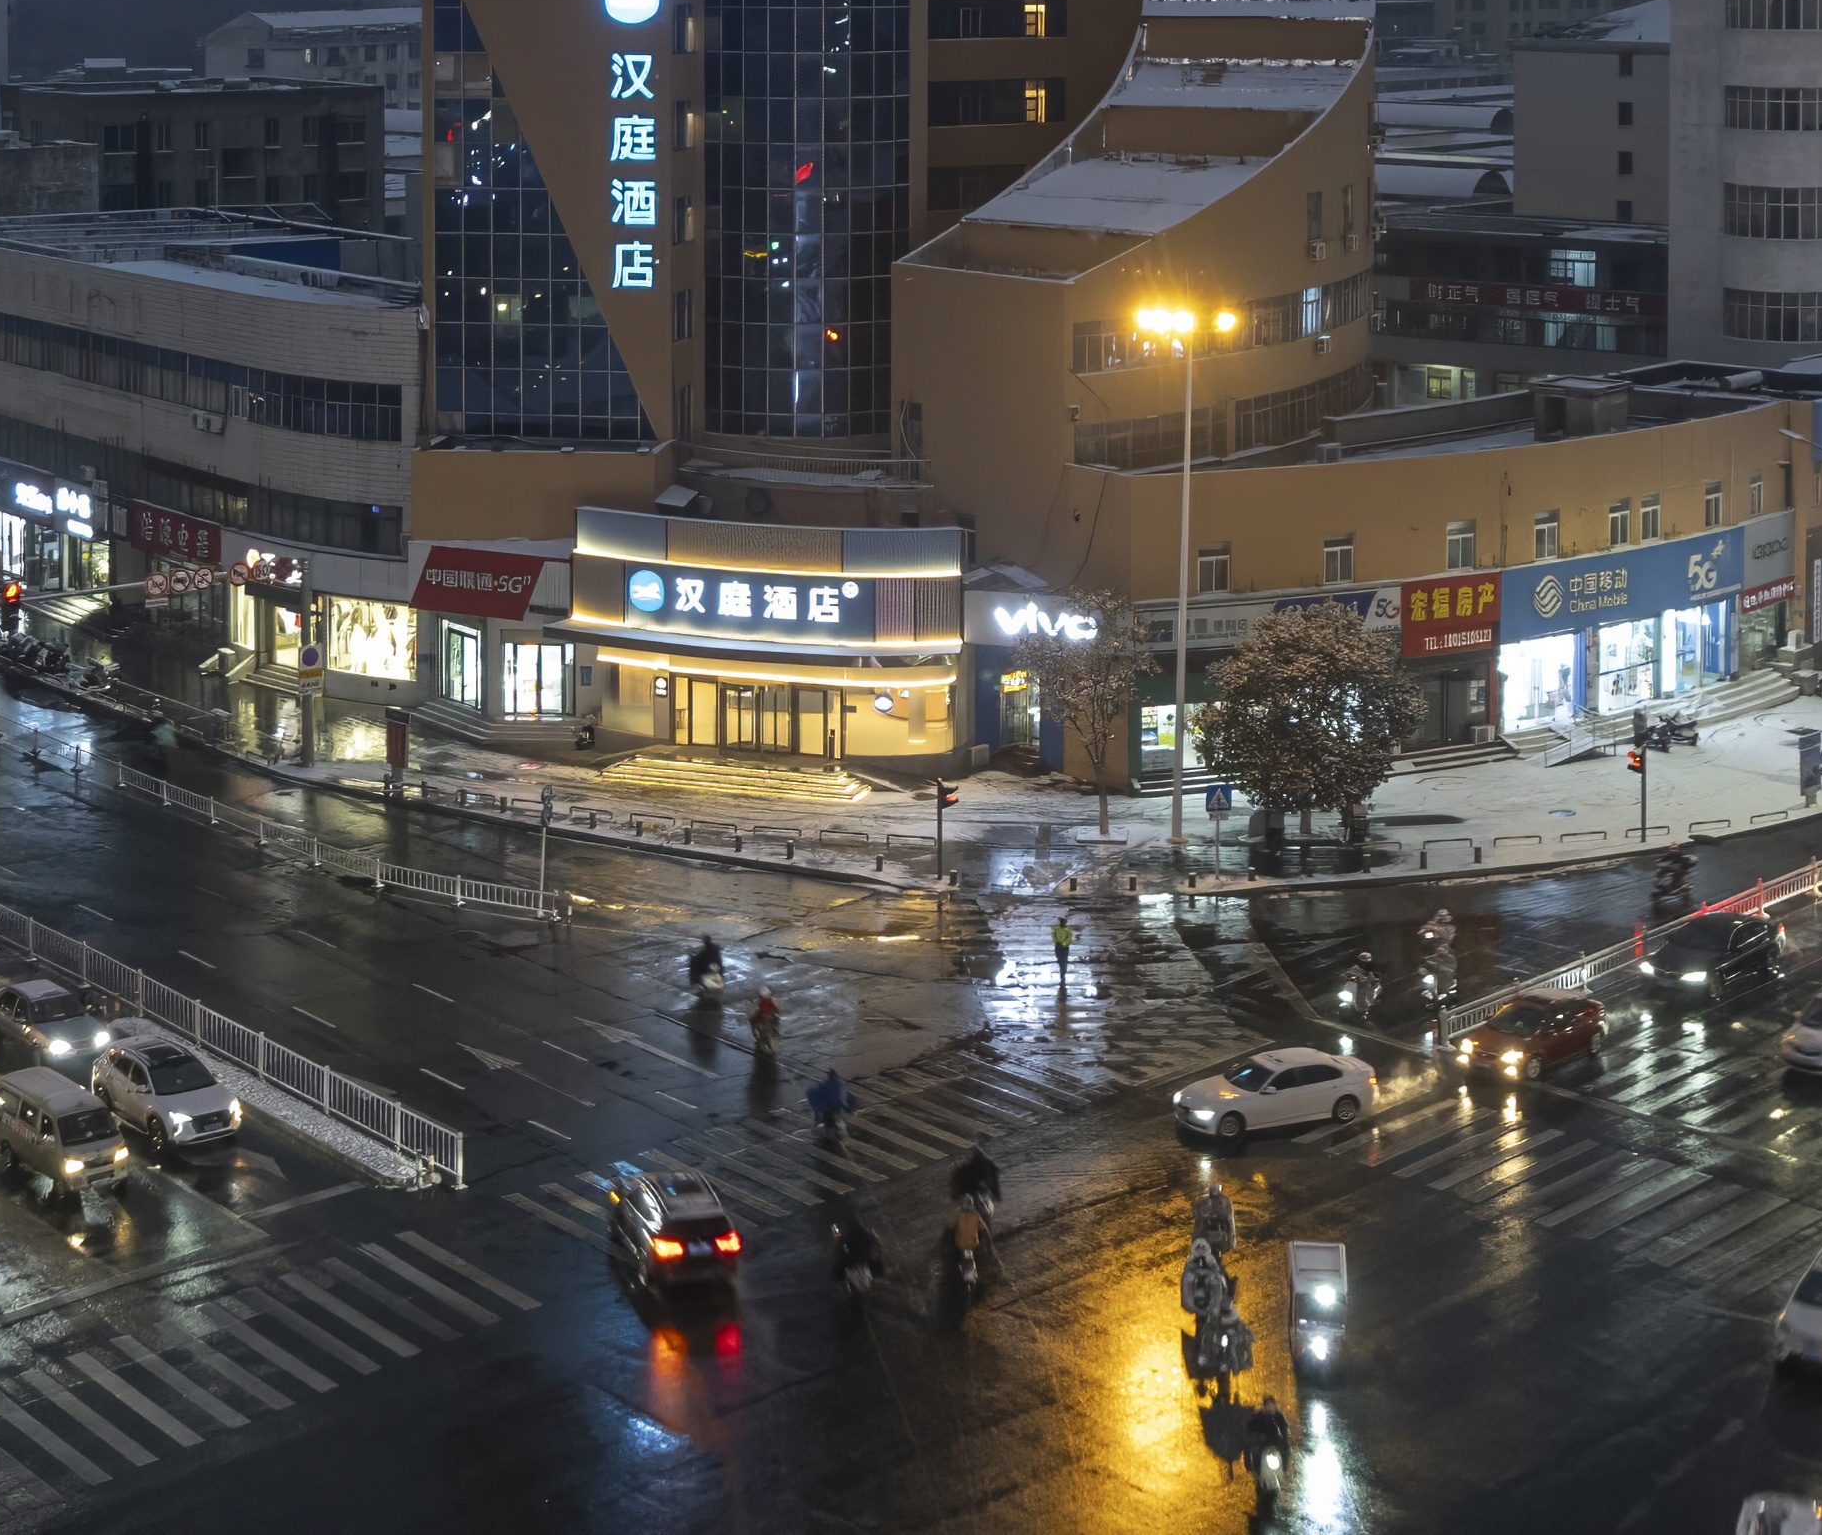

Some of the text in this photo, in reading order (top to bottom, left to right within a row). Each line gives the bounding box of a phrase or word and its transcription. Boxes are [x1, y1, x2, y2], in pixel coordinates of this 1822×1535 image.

[610, 53, 656, 289] 汉庭酒店
[675, 577, 840, 623] 汉庭酒店
[1410, 582, 1494, 621] 宏福房产
[1570, 568, 1628, 596] 中国移动
[994, 601, 1098, 640] vivo
[1375, 597, 1401, 620] 5G
